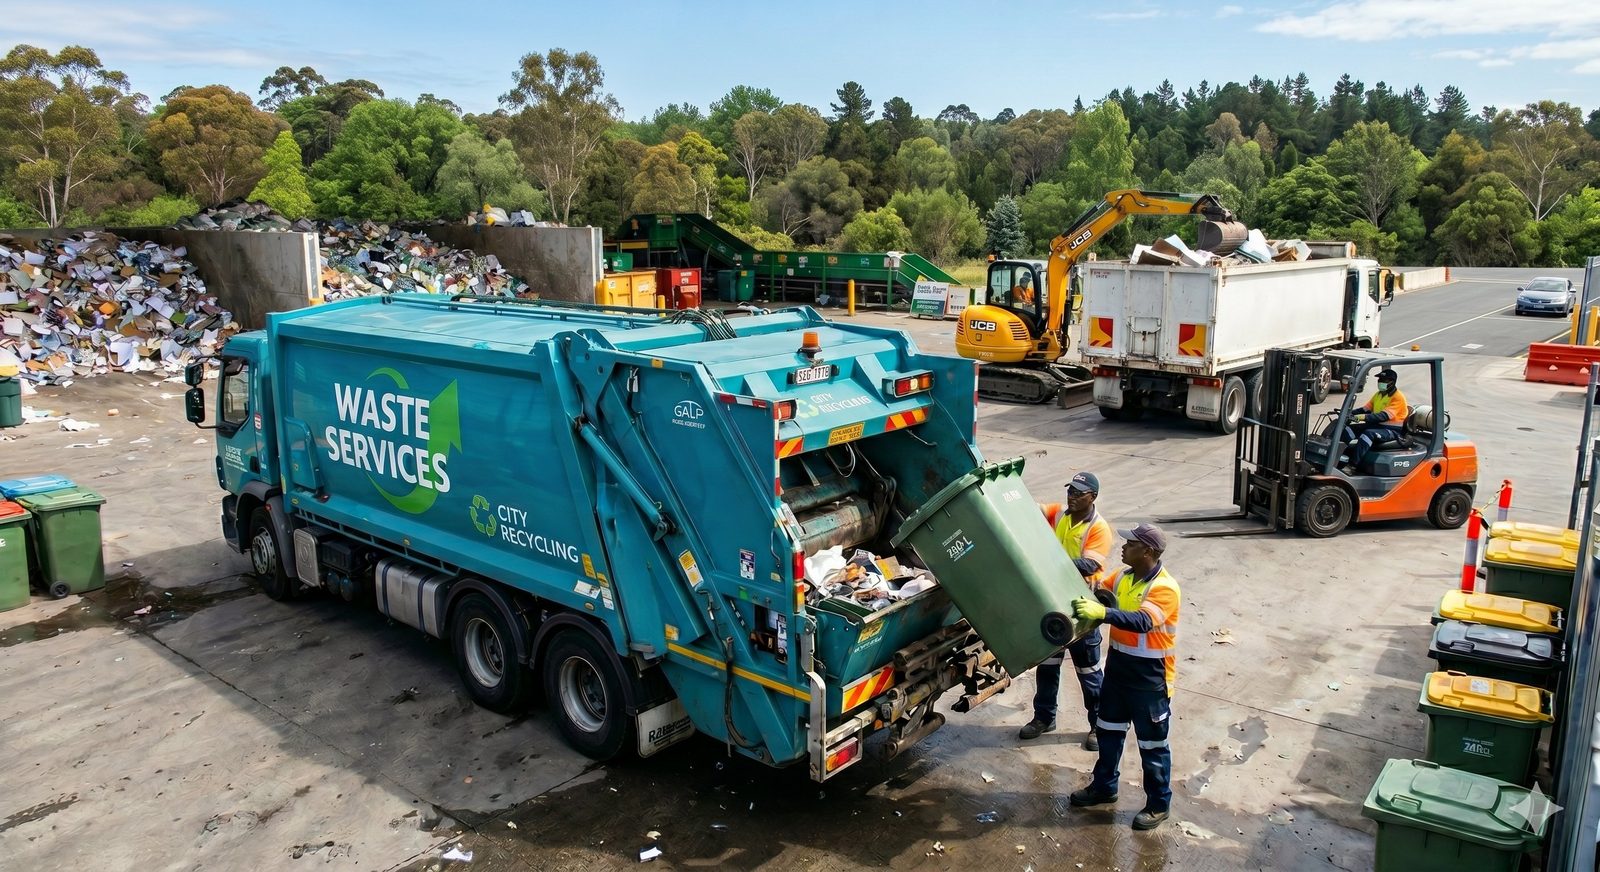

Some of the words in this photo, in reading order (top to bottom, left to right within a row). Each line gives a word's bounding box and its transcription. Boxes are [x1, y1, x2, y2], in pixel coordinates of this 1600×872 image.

[1069, 230, 1093, 249] JCB
[970, 320, 996, 331] JCB
[334, 382, 430, 441] WASTE
[325, 425, 451, 493] SERVICES
[497, 505, 527, 527] CITY
[500, 524, 579, 563] RECYCLING
